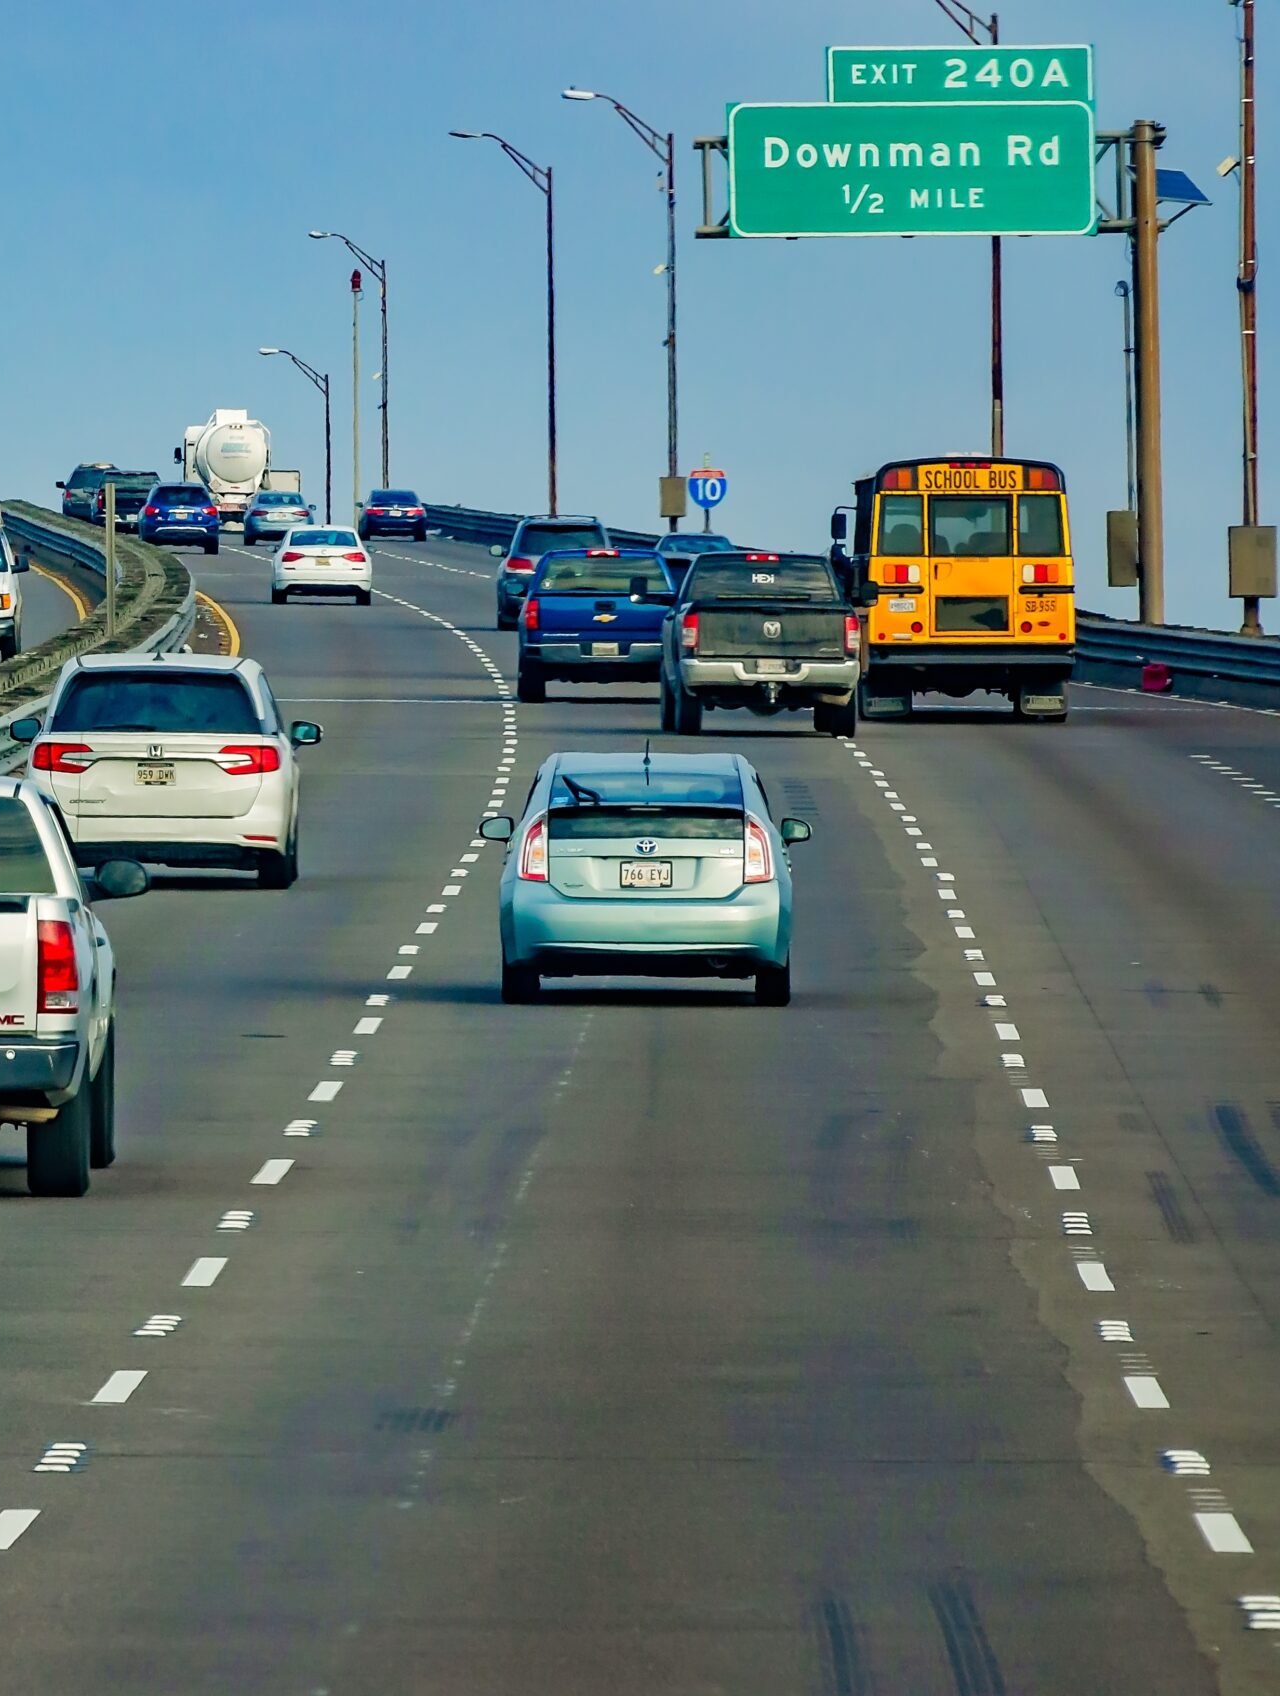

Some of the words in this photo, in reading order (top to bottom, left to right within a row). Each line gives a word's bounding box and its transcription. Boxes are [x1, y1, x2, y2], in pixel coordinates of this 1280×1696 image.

[851, 63, 917, 84] EXIT
[943, 58, 1069, 88] 240A
[764, 135, 981, 168] Downman
[1007, 134, 1059, 166] Rd
[910, 188, 984, 209] MILE
[696, 479, 722, 501] 10
[924, 470, 980, 489] SCHOOL
[988, 470, 1017, 489] BUS
[623, 869, 644, 881] 766
[650, 869, 669, 881] EYJ
